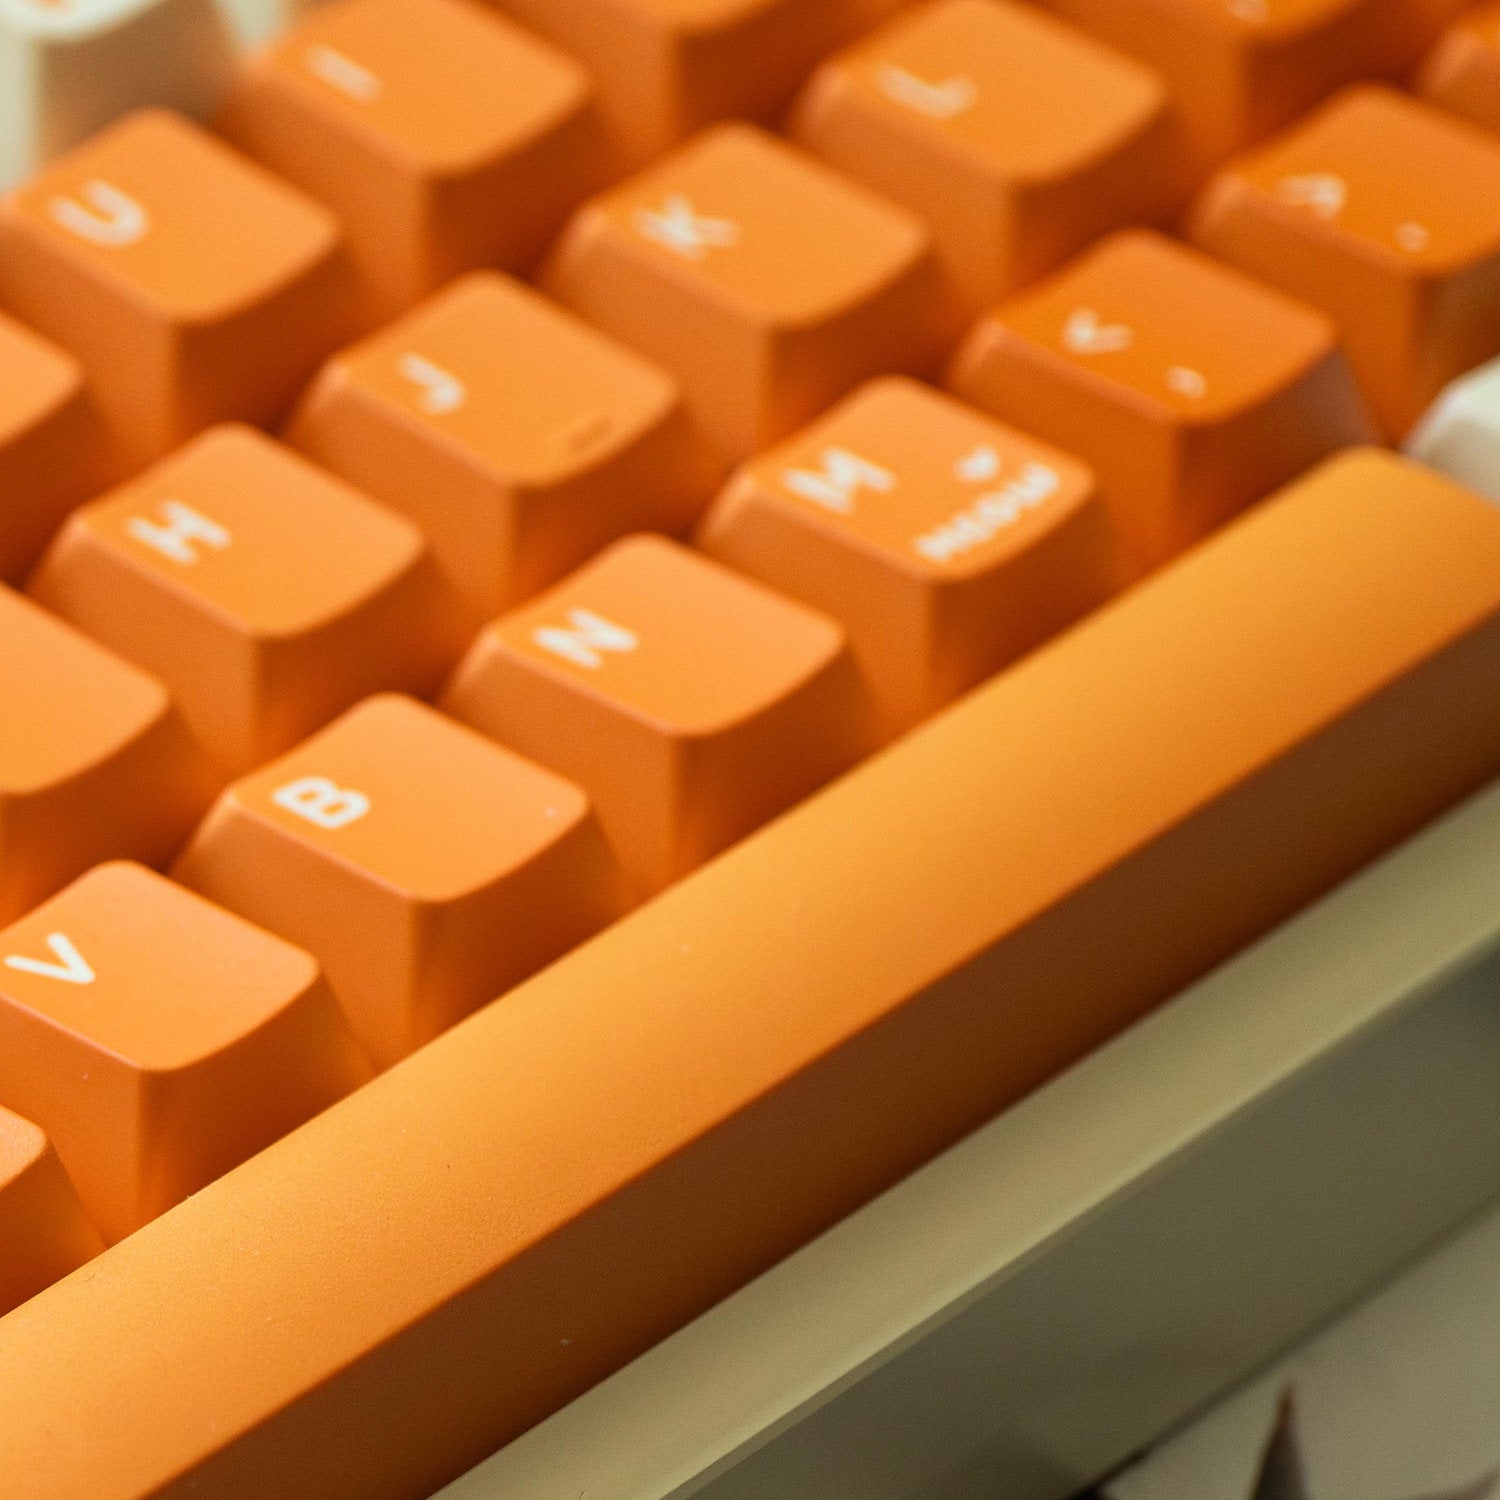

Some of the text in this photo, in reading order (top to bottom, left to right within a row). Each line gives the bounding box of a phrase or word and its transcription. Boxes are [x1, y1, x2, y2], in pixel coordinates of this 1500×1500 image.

[879, 68, 974, 117] L
[54, 182, 146, 245] U
[642, 198, 731, 255] K
[403, 356, 463, 412] J
[785, 449, 892, 511] M
[131, 502, 229, 562] H
[535, 610, 637, 667] N
[273, 777, 369, 828] B
[5, 933, 95, 984] V
